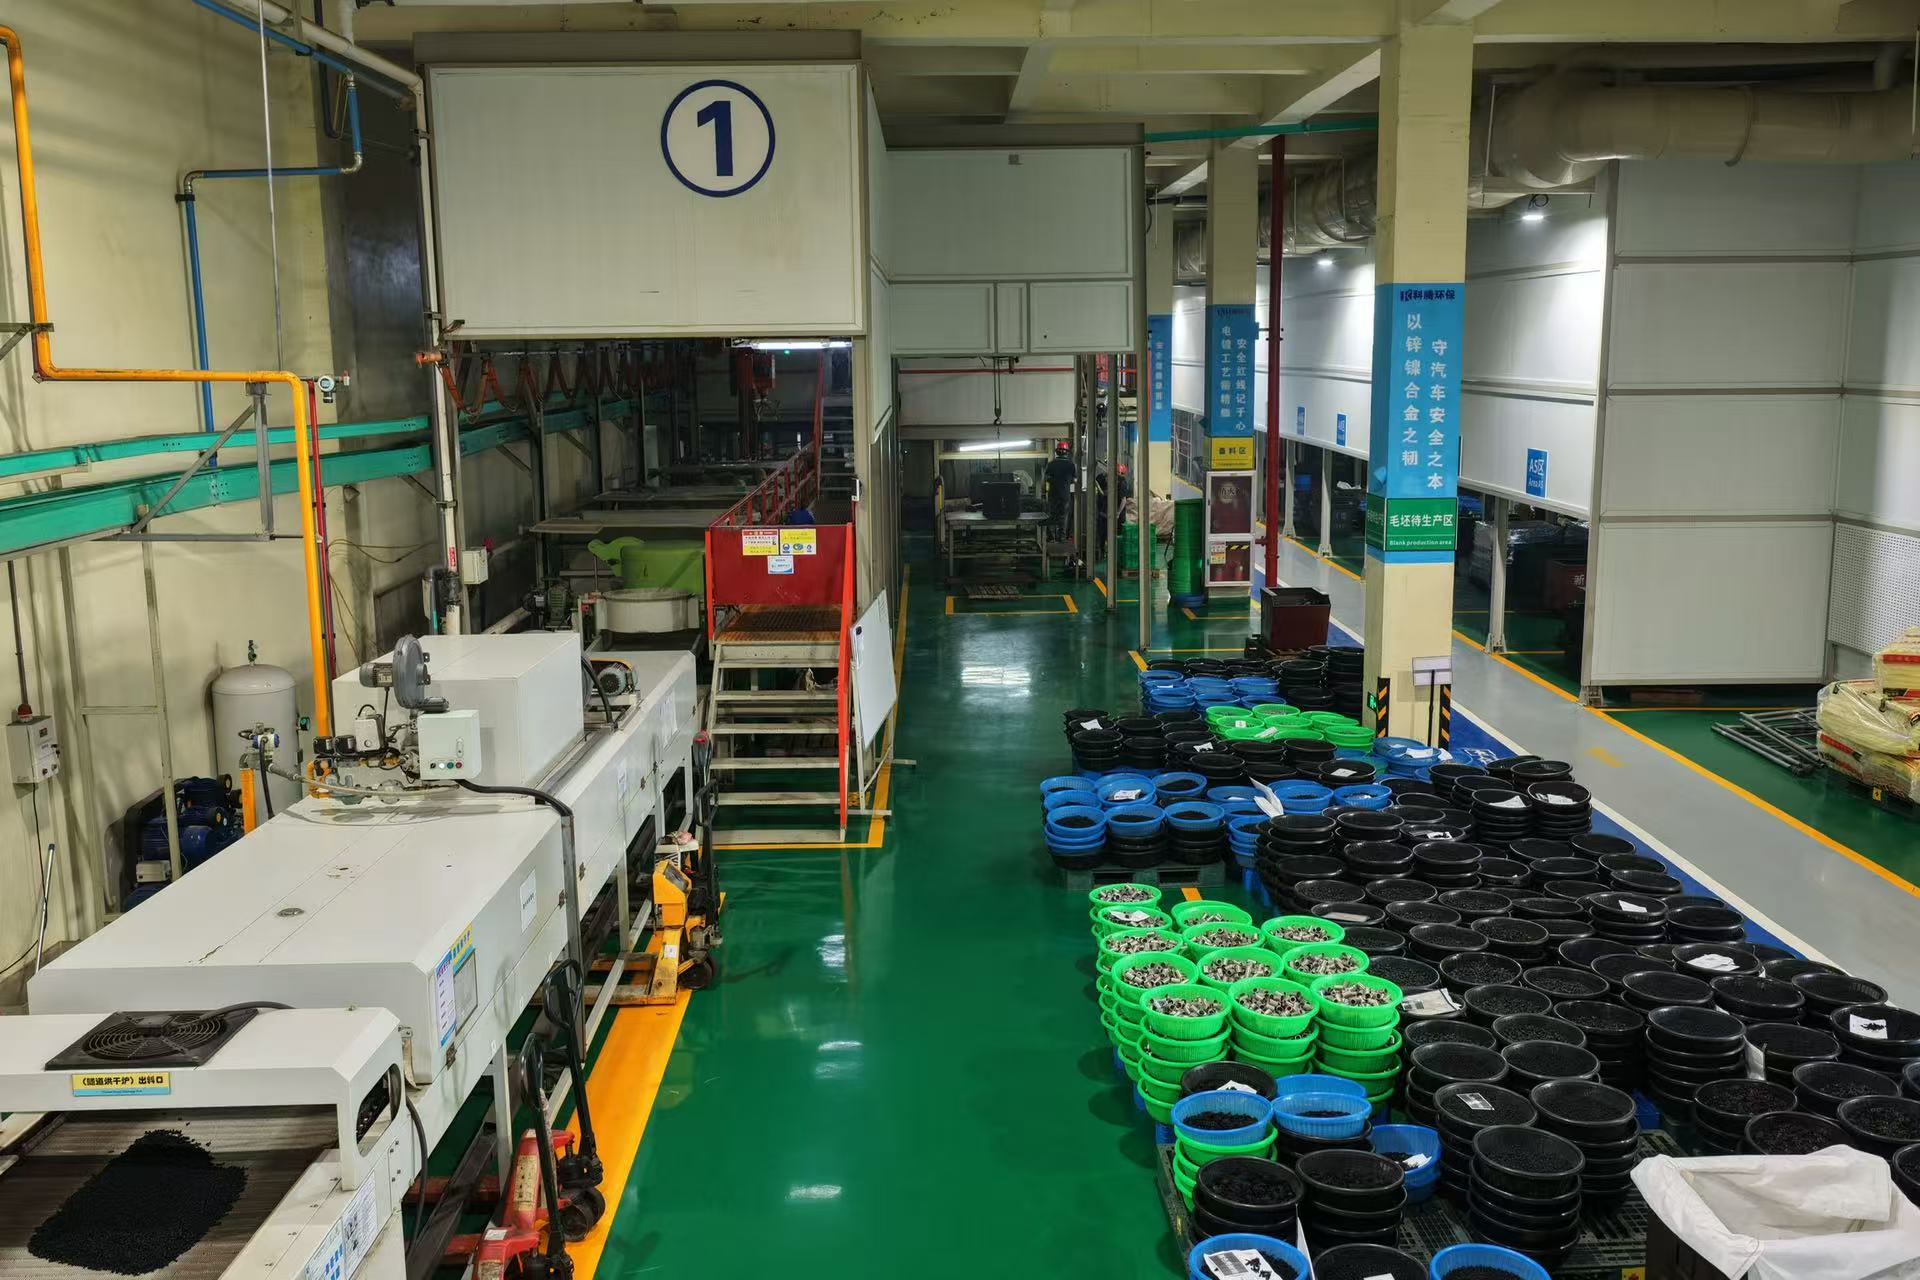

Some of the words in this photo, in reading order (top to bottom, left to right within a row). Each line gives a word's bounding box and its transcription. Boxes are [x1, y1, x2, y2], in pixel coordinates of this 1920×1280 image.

[697, 100, 734, 177] 1
[1427, 338, 1448, 490] 守汽车安全之本
[1389, 514, 1454, 527] 毛坯待生产区
